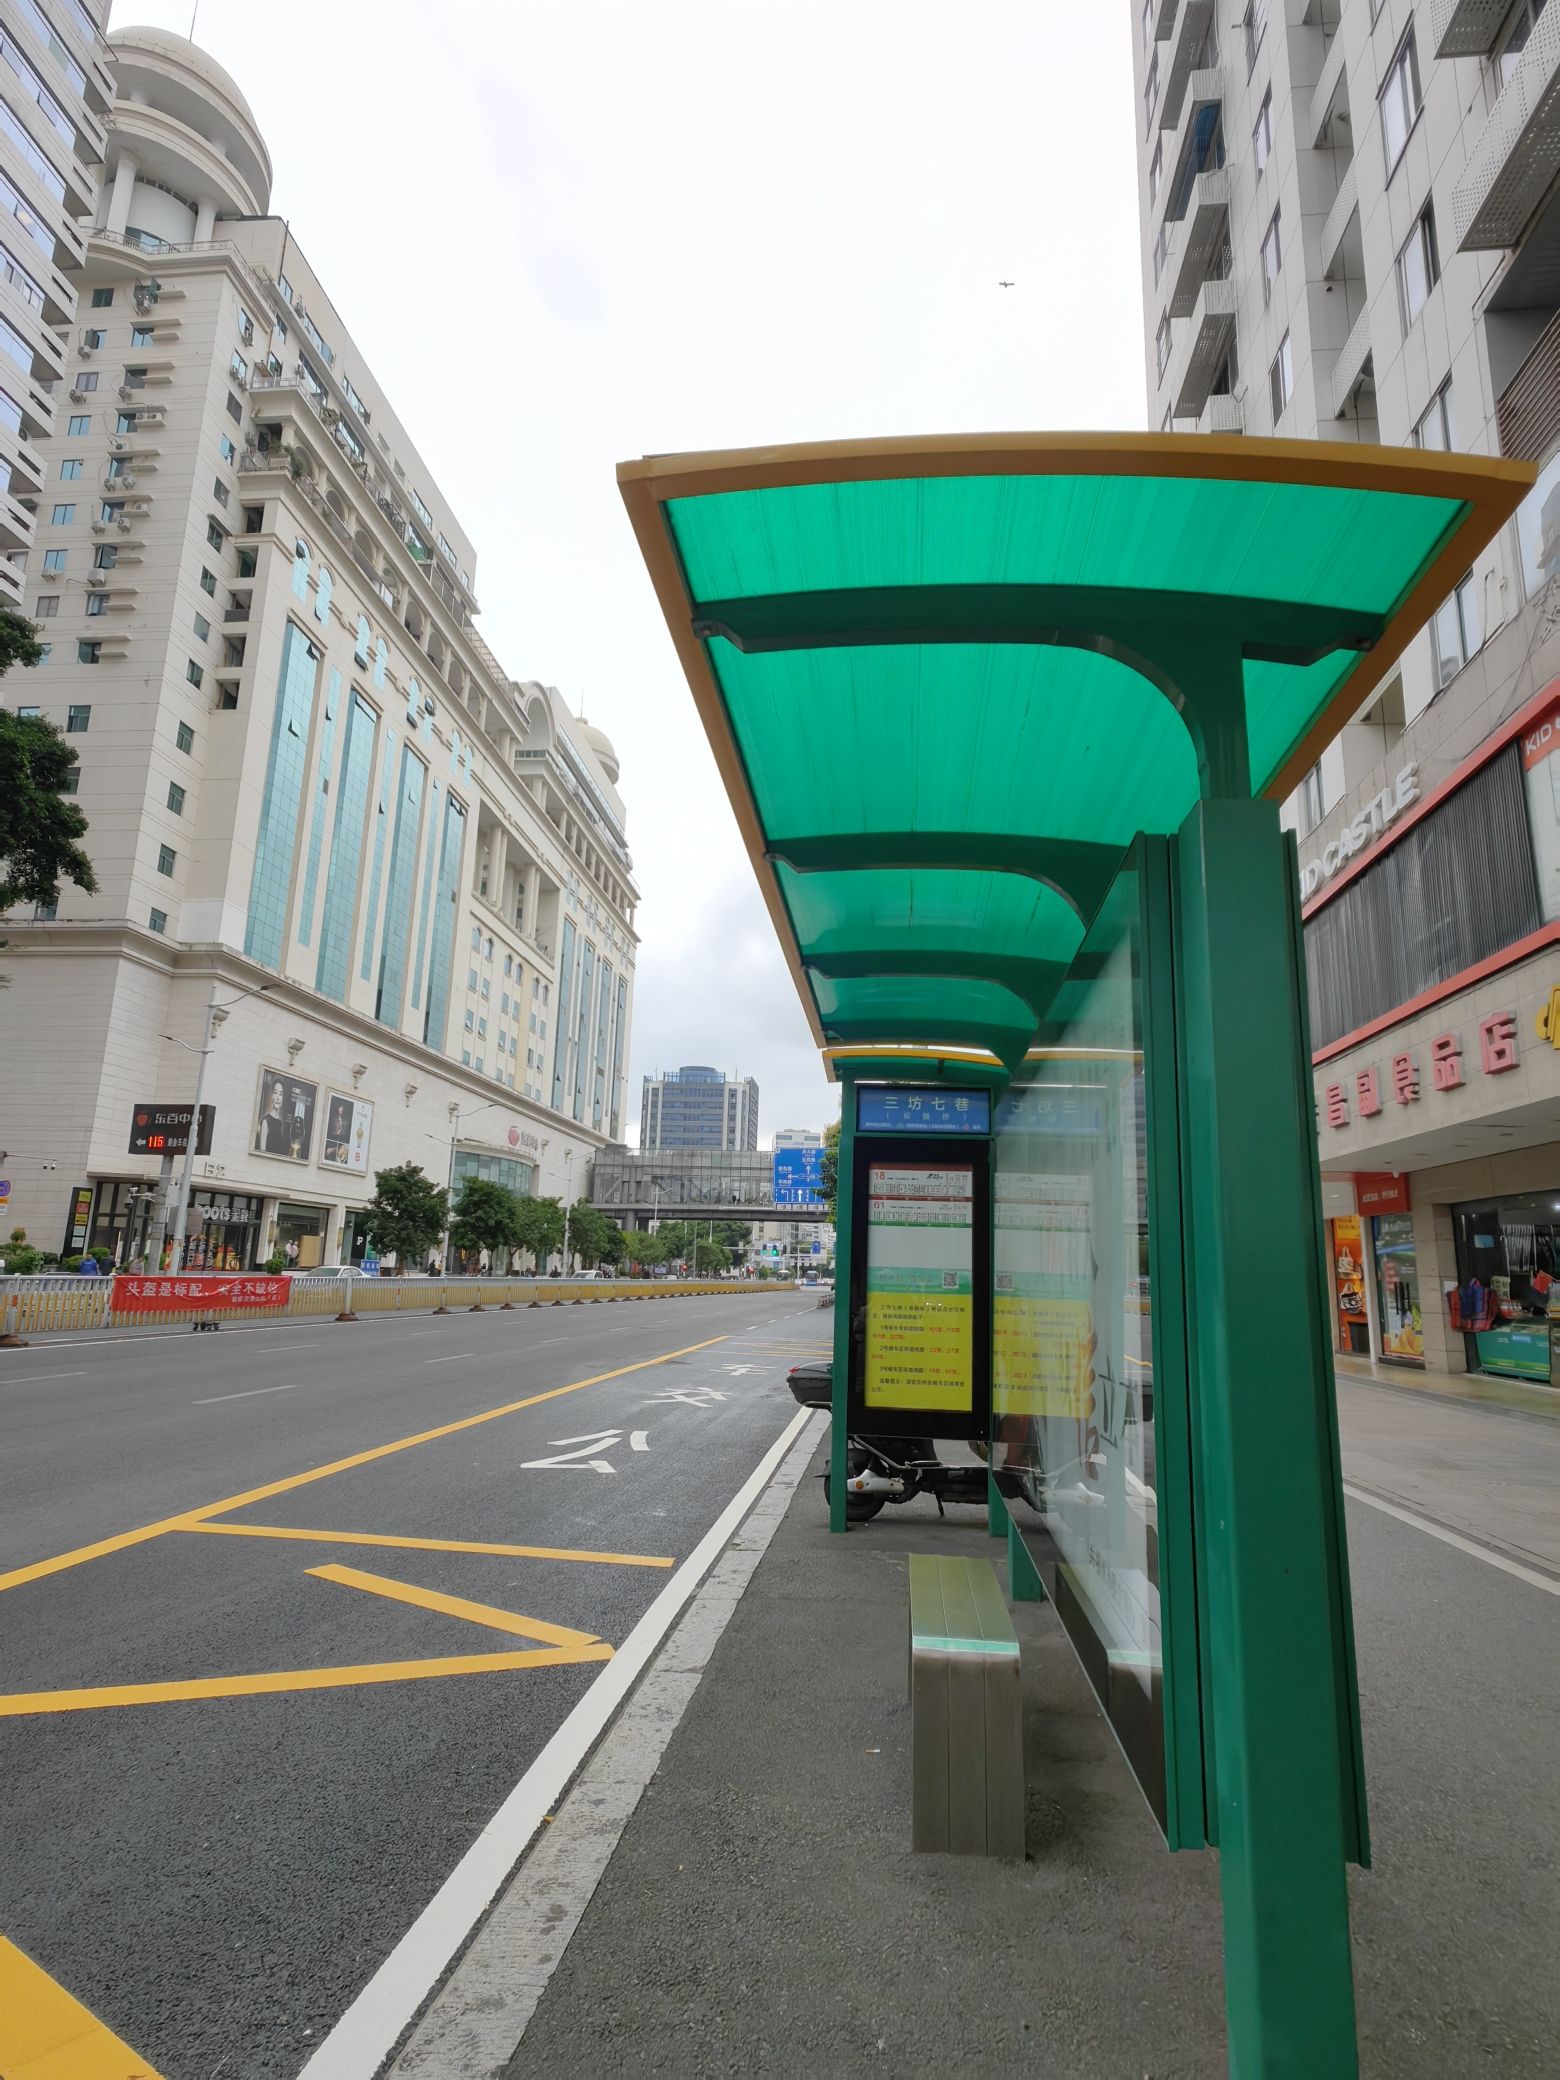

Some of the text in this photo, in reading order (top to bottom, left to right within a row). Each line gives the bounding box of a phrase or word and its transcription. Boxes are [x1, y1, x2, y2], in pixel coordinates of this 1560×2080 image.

[1315, 1011, 1520, 1135] 昌副食品店
[884, 1096, 969, 1111] 三坊七巷
[155, 1113, 203, 1124] 东百中
